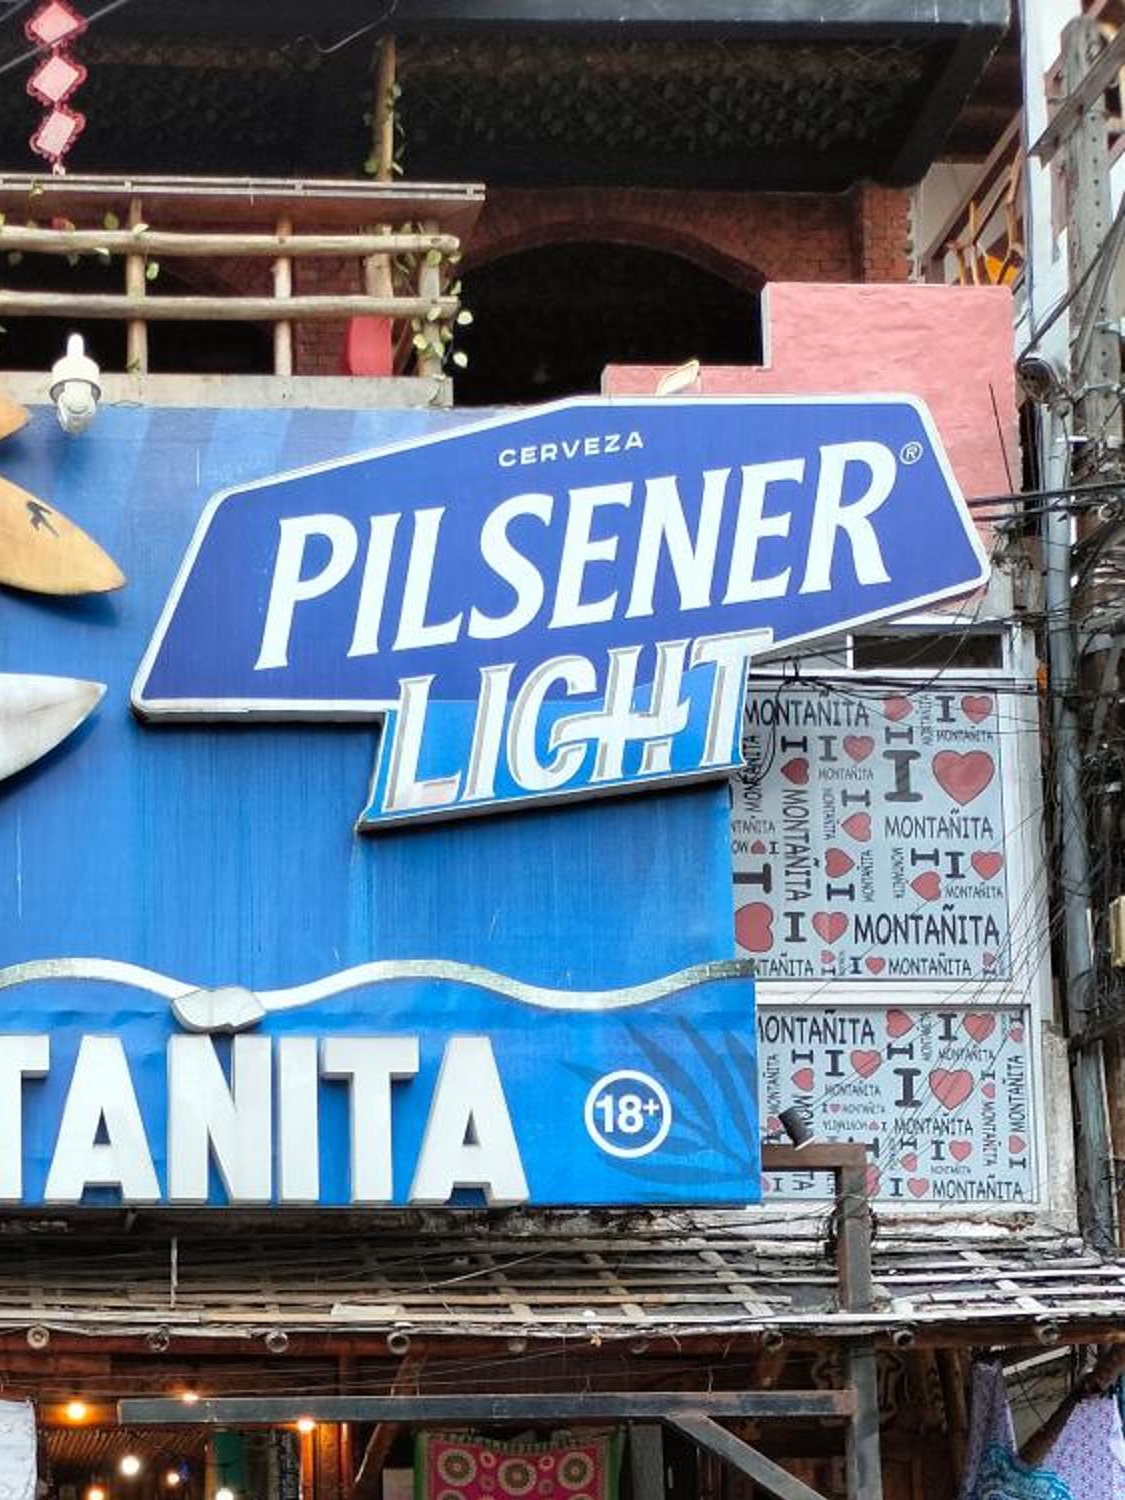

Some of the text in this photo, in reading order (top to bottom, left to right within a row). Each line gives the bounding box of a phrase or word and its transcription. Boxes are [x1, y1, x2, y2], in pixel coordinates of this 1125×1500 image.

[499, 431, 644, 467] CERVEZA
[255, 440, 897, 670] PILSENER
[380, 632, 771, 813] LIGHT
[883, 750, 923, 802] I
[885, 808, 994, 838] MONTAÑITA
[783, 789, 820, 901] MONTAÑITA
[784, 904, 1000, 946] I MONTAÑITA
[888, 952, 972, 976] MONTAÑITA
[893, 1067, 923, 1108] I
[596, 1094, 660, 1134] 18+
[933, 1174, 1025, 1200] MONTAÑITA
